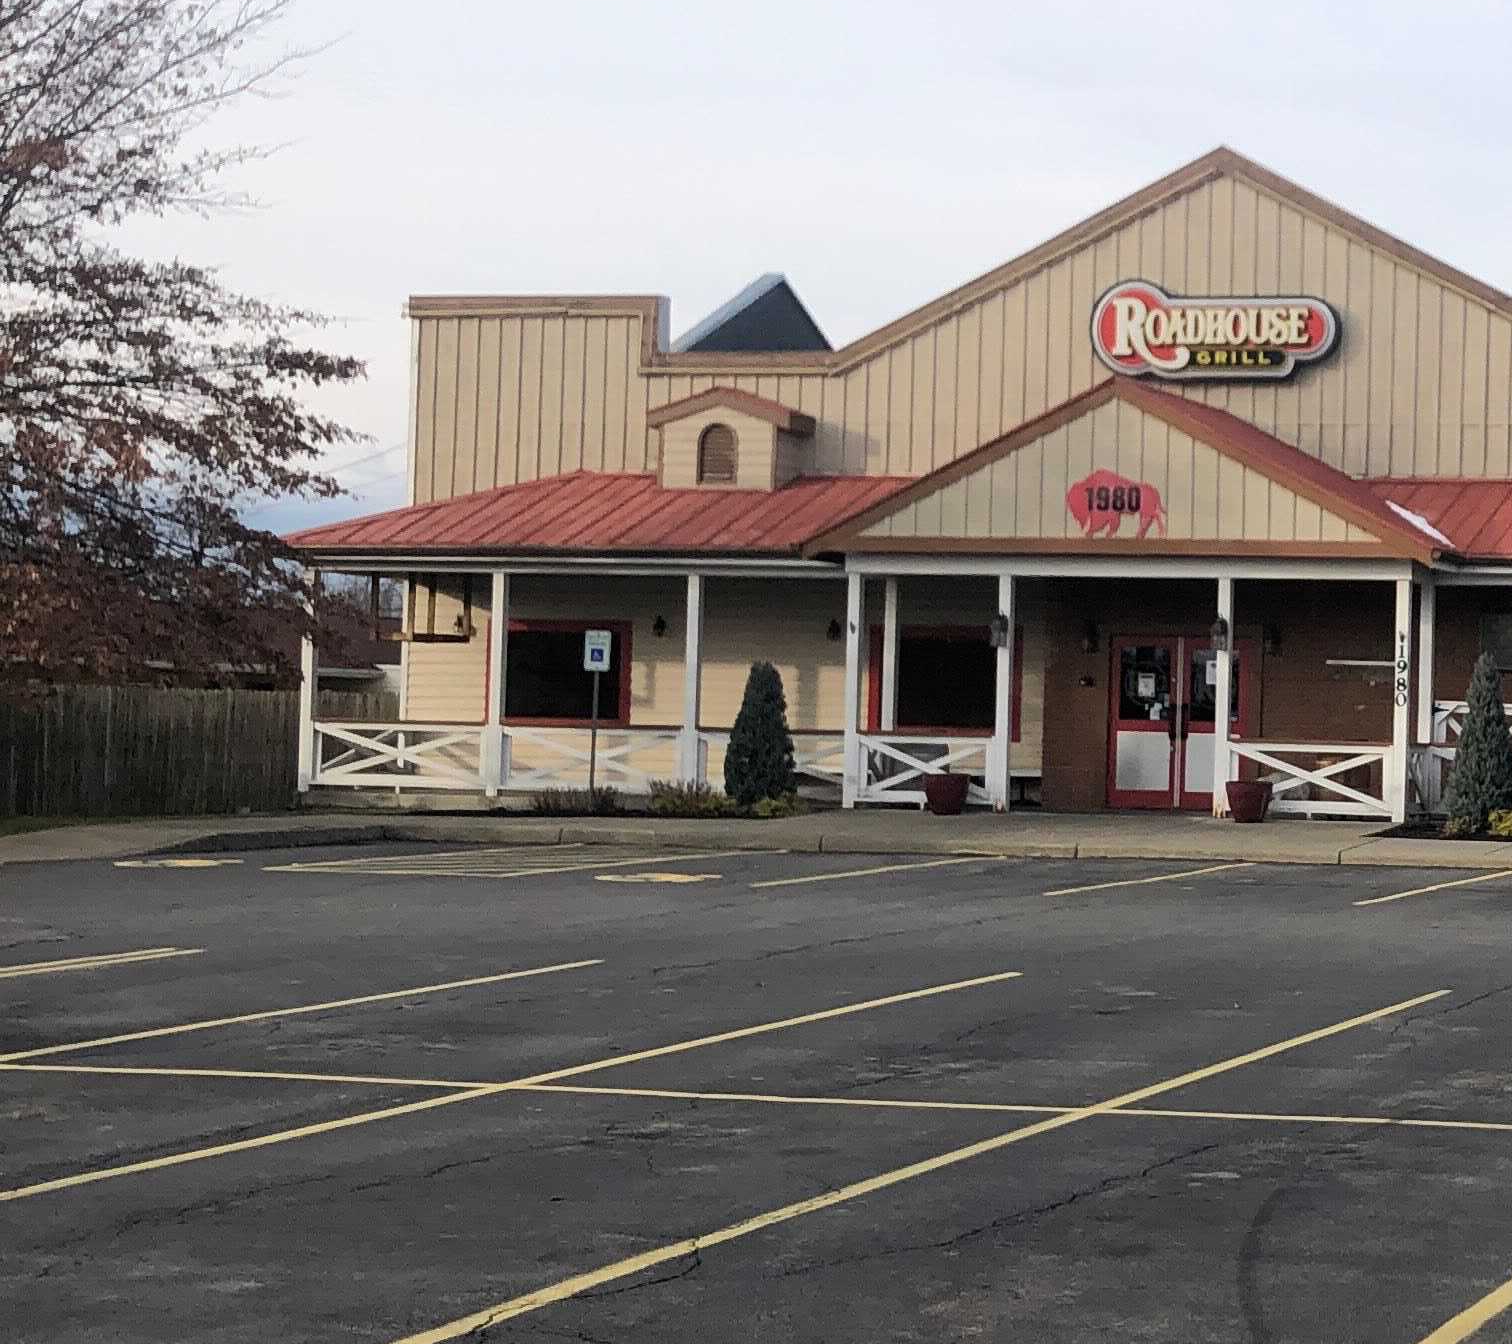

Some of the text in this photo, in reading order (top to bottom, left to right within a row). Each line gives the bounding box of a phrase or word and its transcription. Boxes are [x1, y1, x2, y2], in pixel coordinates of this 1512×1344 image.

[1112, 296, 1310, 371] ROADHOUSE
[1196, 350, 1272, 366] GRILL
[1086, 485, 1142, 513] 1980
[1396, 644, 1408, 708] 1980
